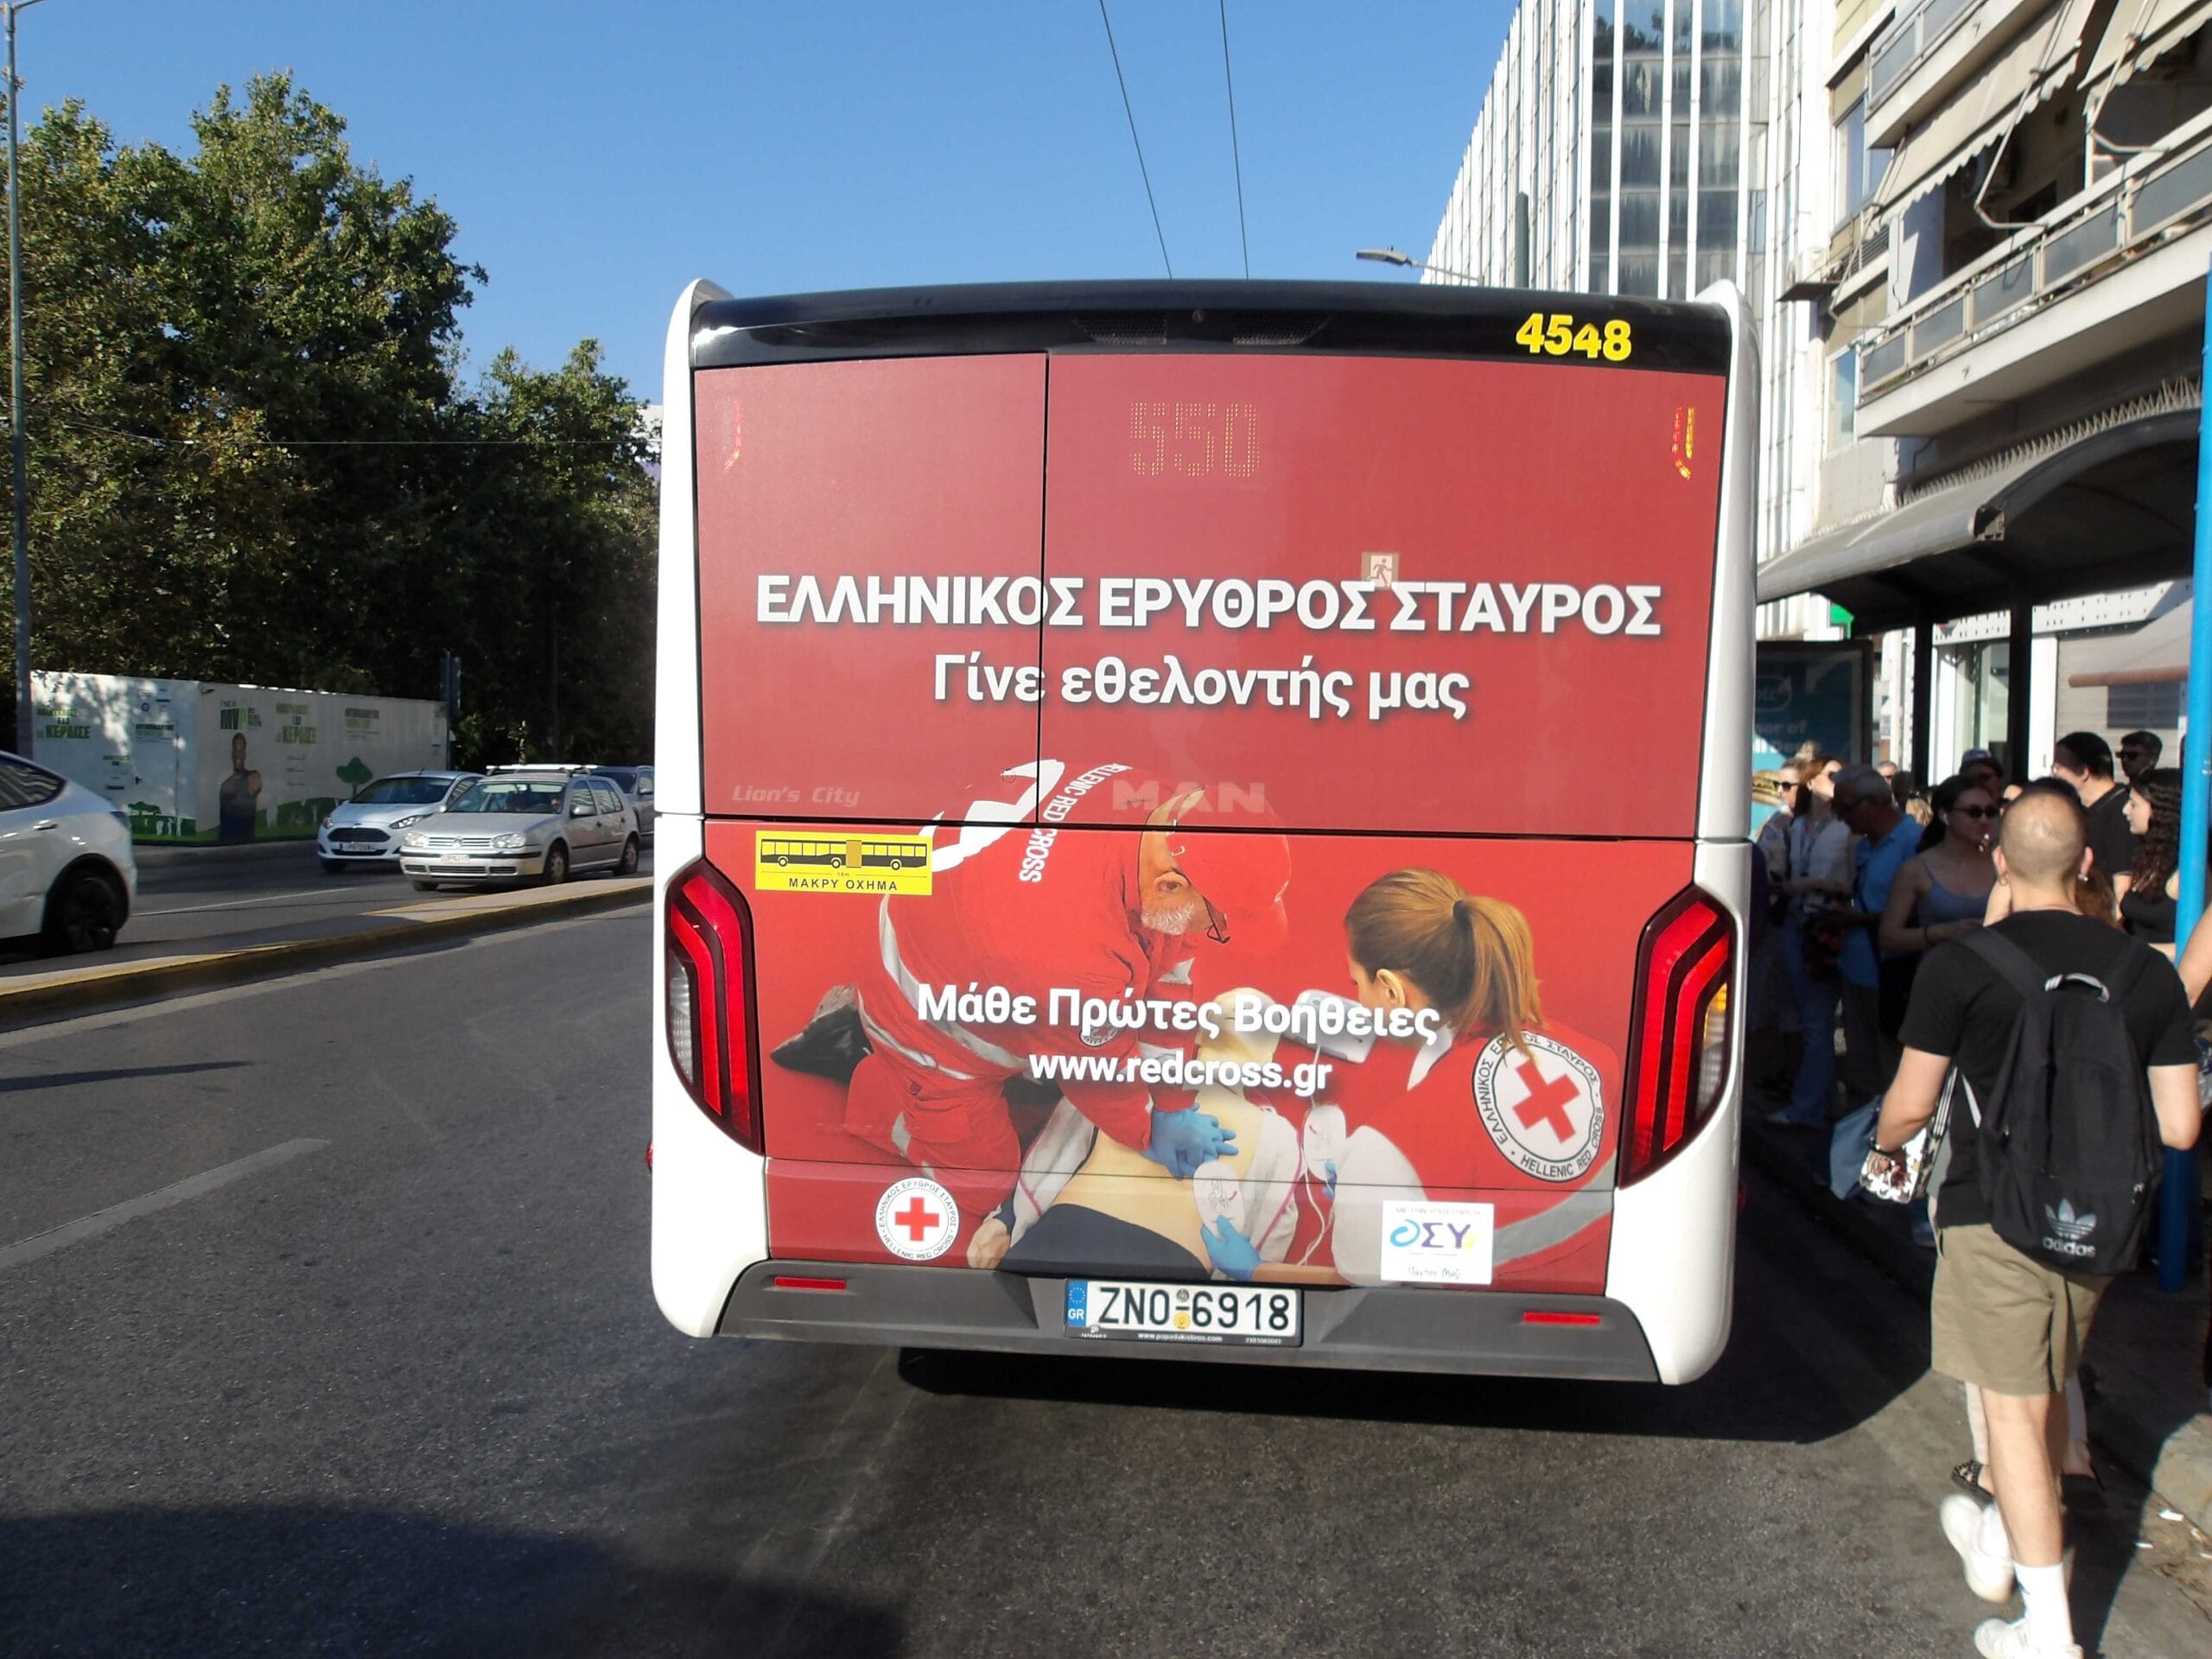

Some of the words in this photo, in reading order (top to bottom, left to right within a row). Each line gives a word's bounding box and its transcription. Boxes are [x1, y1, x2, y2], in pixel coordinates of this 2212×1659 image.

[1516, 312, 1631, 361] 4548
[757, 575, 1084, 626] ΕΛΛΗΝΙΚΟΣ
[1099, 577, 1375, 630] ΕΡΥΘΡΟΣ
[1389, 582, 1662, 636] ΣΤΑΥΡΟΣ
[934, 651, 1046, 702] Γίνε
[1061, 655, 1352, 719] εθελοντής
[1369, 671, 1470, 720] μας
[732, 785, 801, 803] Lion's
[811, 787, 860, 808] City
[1042, 795, 1078, 822] RED
[1112, 779, 1265, 813] MAN
[1019, 829, 1058, 882] CROSS
[789, 878, 838, 889] ΜΑΚΡΥ
[846, 880, 897, 891] ΟΧΗΜΑ
[918, 982, 1037, 1025] Μάθε
[1048, 988, 1223, 1039] Πρώτες
[1028, 1051, 1332, 1097] www.redcross.gr
[1478, 1058, 1508, 1145] ΕΛΛΗΝΙΚΟΣ
[1521, 1154, 1574, 1178] HELLENIC
[1576, 1150, 1592, 1170] RED
[1591, 1106, 1603, 1148] CROSS
[2043, 1236, 2096, 1258] adidas
[1068, 1308, 1084, 1319] GR
